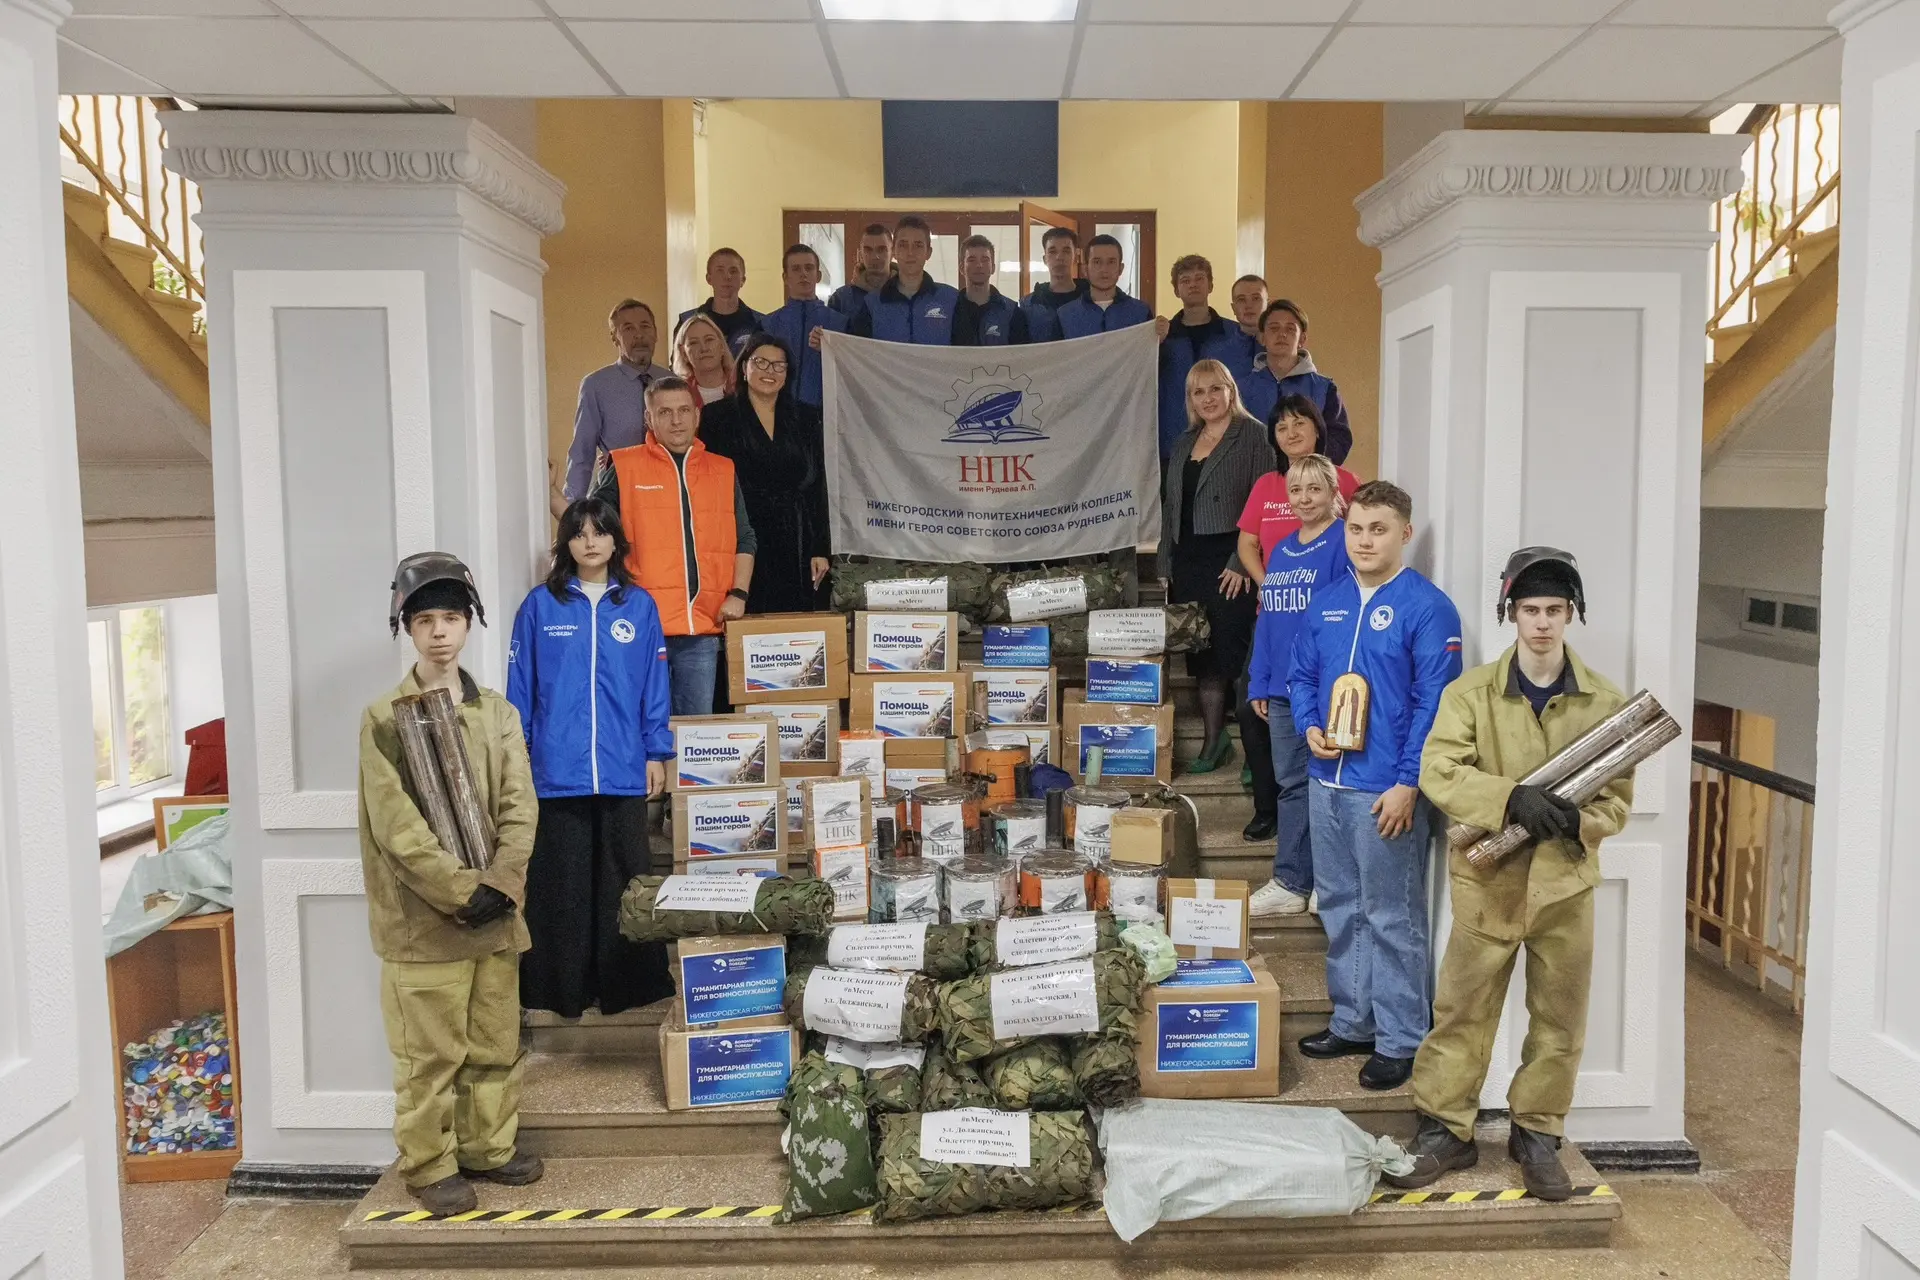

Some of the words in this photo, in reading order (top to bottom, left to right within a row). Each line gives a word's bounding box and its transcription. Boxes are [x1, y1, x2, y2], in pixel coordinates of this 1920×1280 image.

[959, 454, 1036, 483] НПК
[986, 485, 1019, 494] Руднева
[1020, 484, 1036, 492] А.П.
[867, 500, 964, 519] НИЖЕГОРОДСКИЙ
[968, 500, 1079, 520] ПОЛИТЕХНИЧЕСКИЙ
[1081, 490, 1132, 510] КОЛЛЕДЖ
[867, 518, 906, 530] ИМЕНИ
[909, 522, 943, 534] ГЕРОЯ
[947, 526, 1021, 538] СОВЕТСКОГО
[1025, 523, 1065, 536] СОЮЗА
[1068, 513, 1114, 530] РУДНЕВА
[1118, 506, 1138, 518] А.П.
[873, 634, 922, 643] Помощь
[750, 653, 801, 663] Помощь
[988, 690, 1025, 698] омощь
[880, 701, 929, 710] Помощь
[778, 724, 802, 733] ощь
[685, 746, 739, 756] Помощь
[713, 755, 740, 763] героям
[695, 816, 750, 825] Помощь
[724, 823, 751, 831] героям
[825, 825, 856, 839] НПК
[931, 844, 959, 856] НПК
[1013, 936, 1047, 944] Сплетено
[880, 944, 914, 952] вручную,
[691, 982, 745, 994] ГУМАНИТАРНАЯ
[746, 978, 778, 987] ПОМОЩЬ
[694, 994, 708, 1002] ДЛЯ
[710, 986, 777, 1000] ВОЕННОСЛУЖАЩИХ
[1011, 998, 1023, 1006] ул.
[1074, 991, 1077, 999] 1
[689, 1006, 751, 1019] НИЖЕГОРОДСКАЯ
[1003, 1017, 1031, 1026] ПОБЕДА
[1182, 1040, 1248, 1048] ВОЕННОСЛУЖАЩИХ
[1222, 1059, 1253, 1067] ОБЛАСТЬ
[696, 1063, 750, 1074] ГУМАНИТАРНАЯ
[698, 1075, 712, 1083] ДЛЯ
[714, 1070, 782, 1082] ВОЕННОСЛУЖАЩИХ
[693, 1090, 754, 1101] НИЖЕГОРОДСКАЯ
[961, 1116, 994, 1124] #вМесте
[956, 1127, 1005, 1136] Должанская,
[939, 1136, 976, 1144] Сплетено
[978, 1139, 1014, 1148] вручную,
[973, 1149, 1017, 1158] любовью!!!
